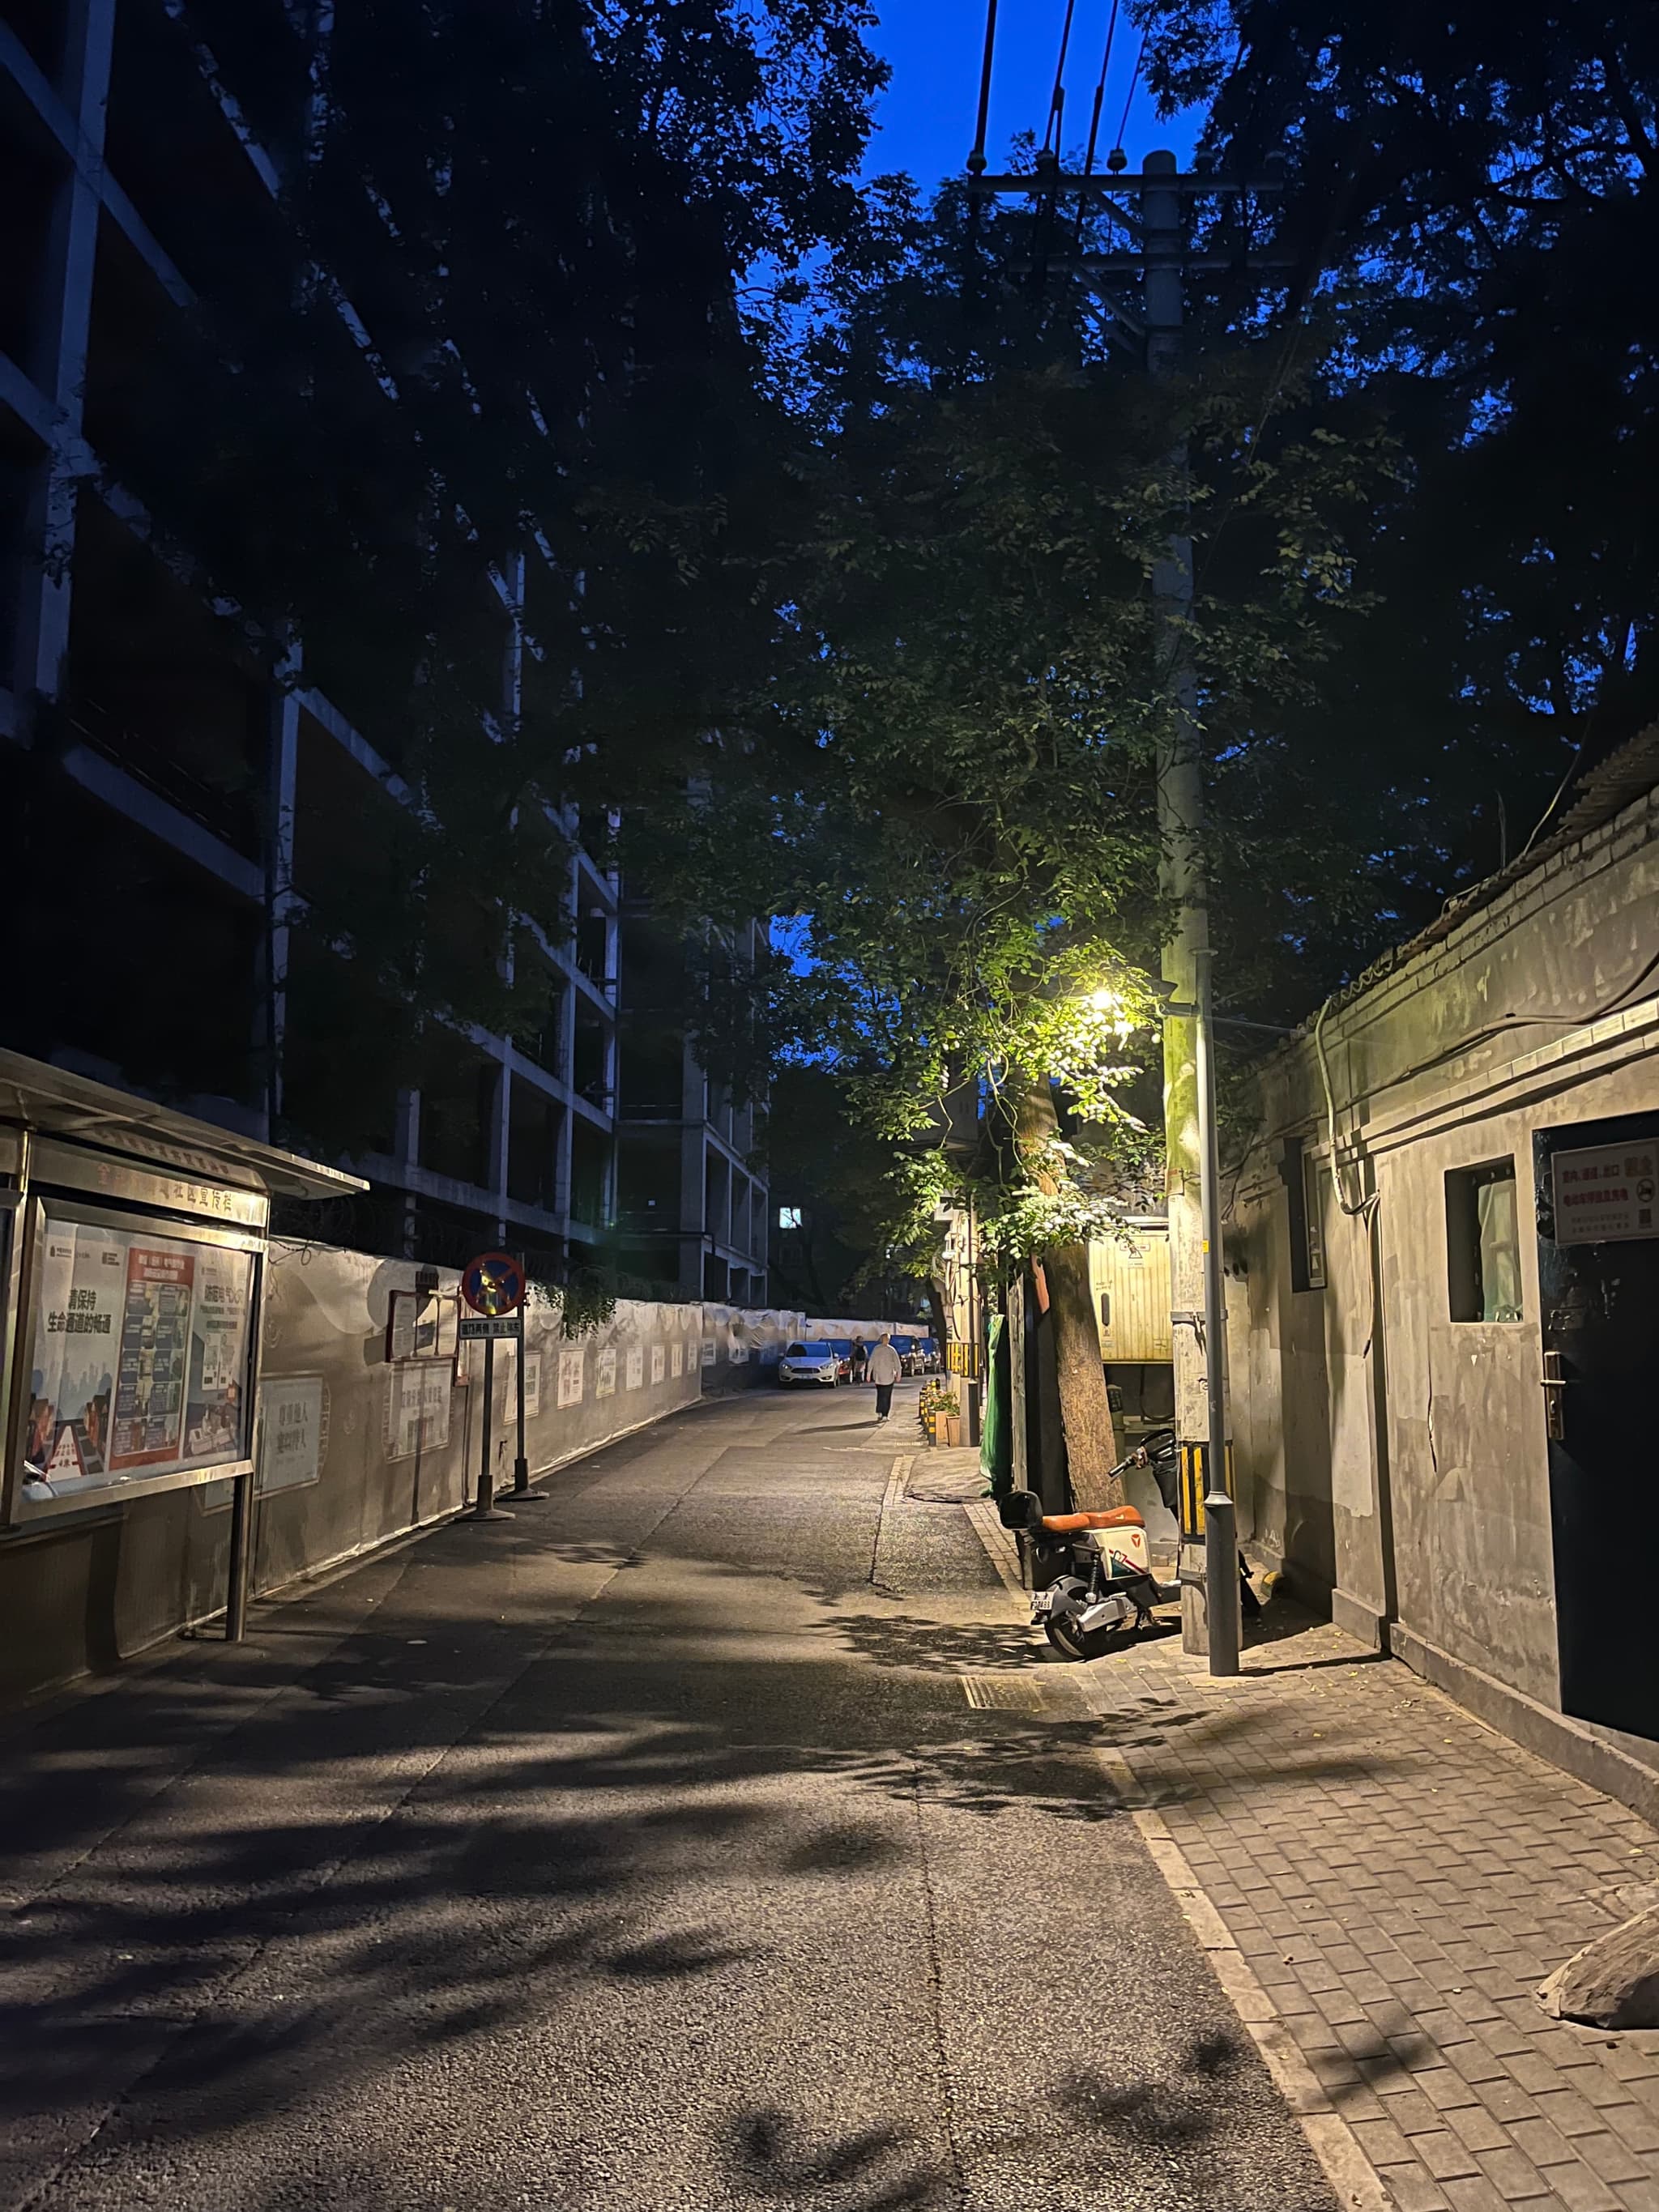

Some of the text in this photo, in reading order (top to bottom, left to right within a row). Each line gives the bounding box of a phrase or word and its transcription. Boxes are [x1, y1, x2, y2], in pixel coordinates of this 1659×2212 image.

[67, 1289, 96, 1311] 请保持
[47, 1311, 111, 1335] 生命通道的畅通
